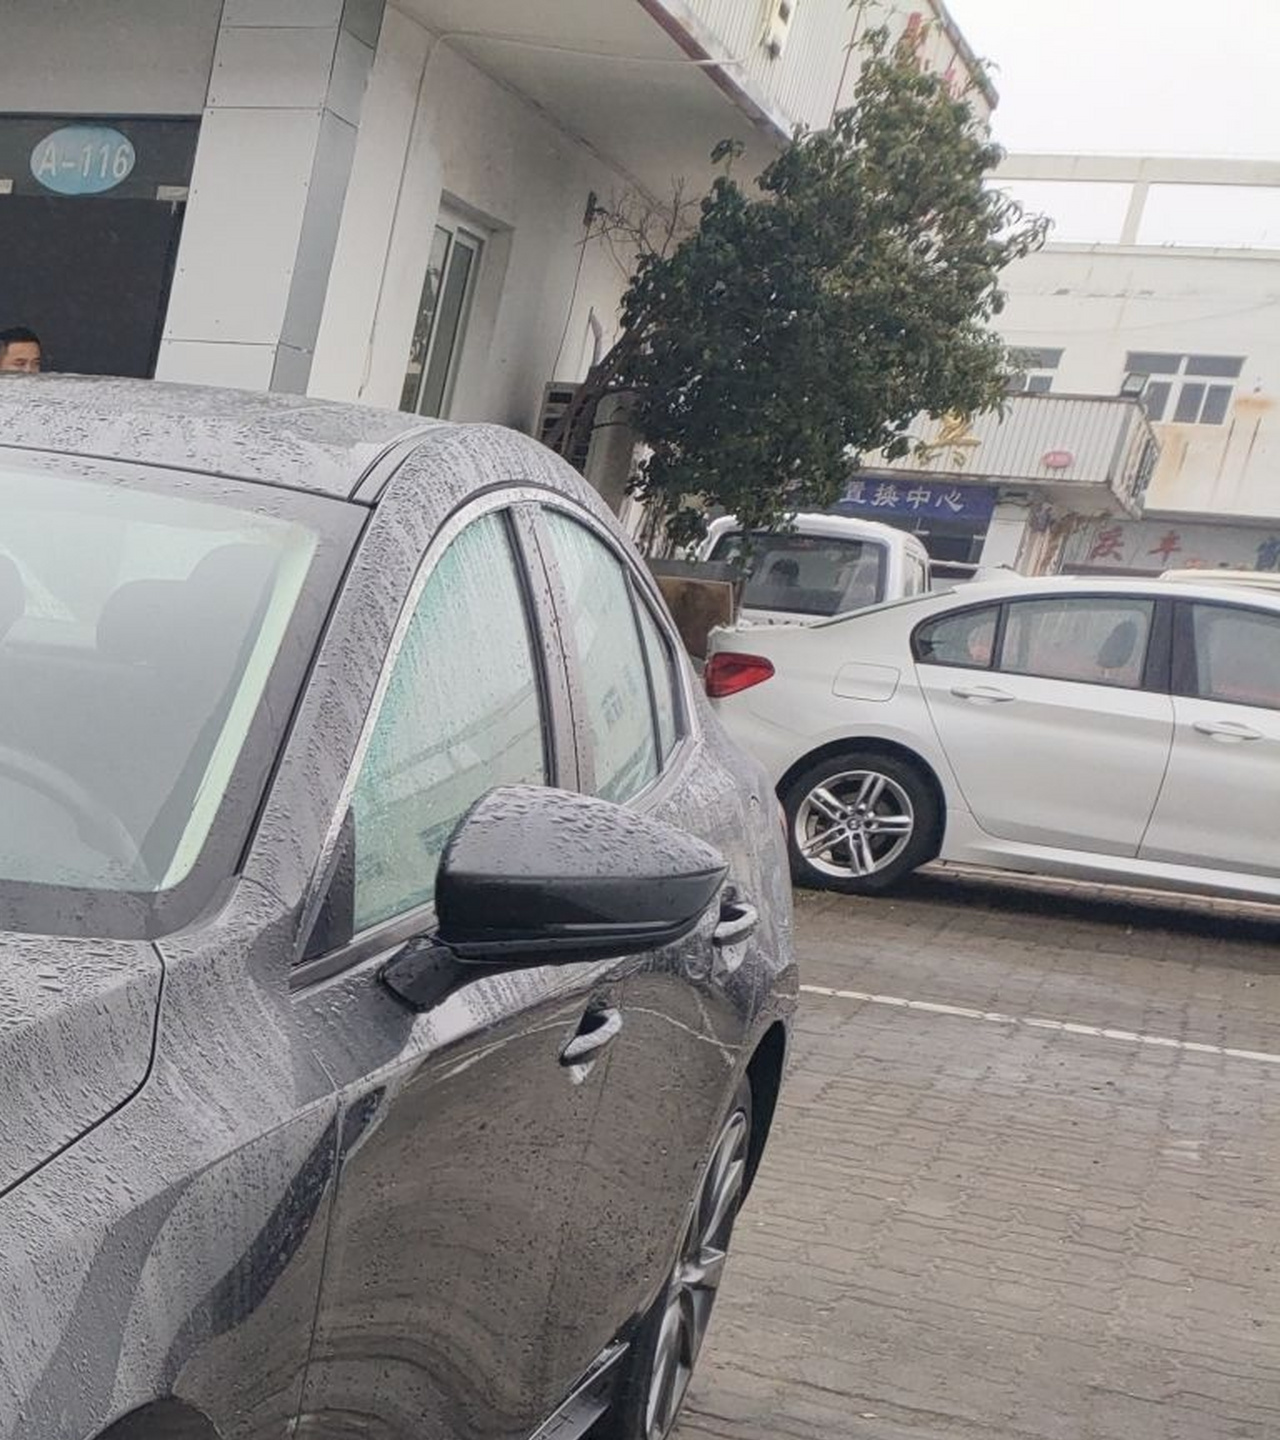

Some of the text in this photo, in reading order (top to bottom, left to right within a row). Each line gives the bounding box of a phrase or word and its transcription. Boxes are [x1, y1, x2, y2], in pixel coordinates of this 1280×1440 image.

[39, 141, 130, 179] A-116
[840, 480, 965, 512] 置换中心
